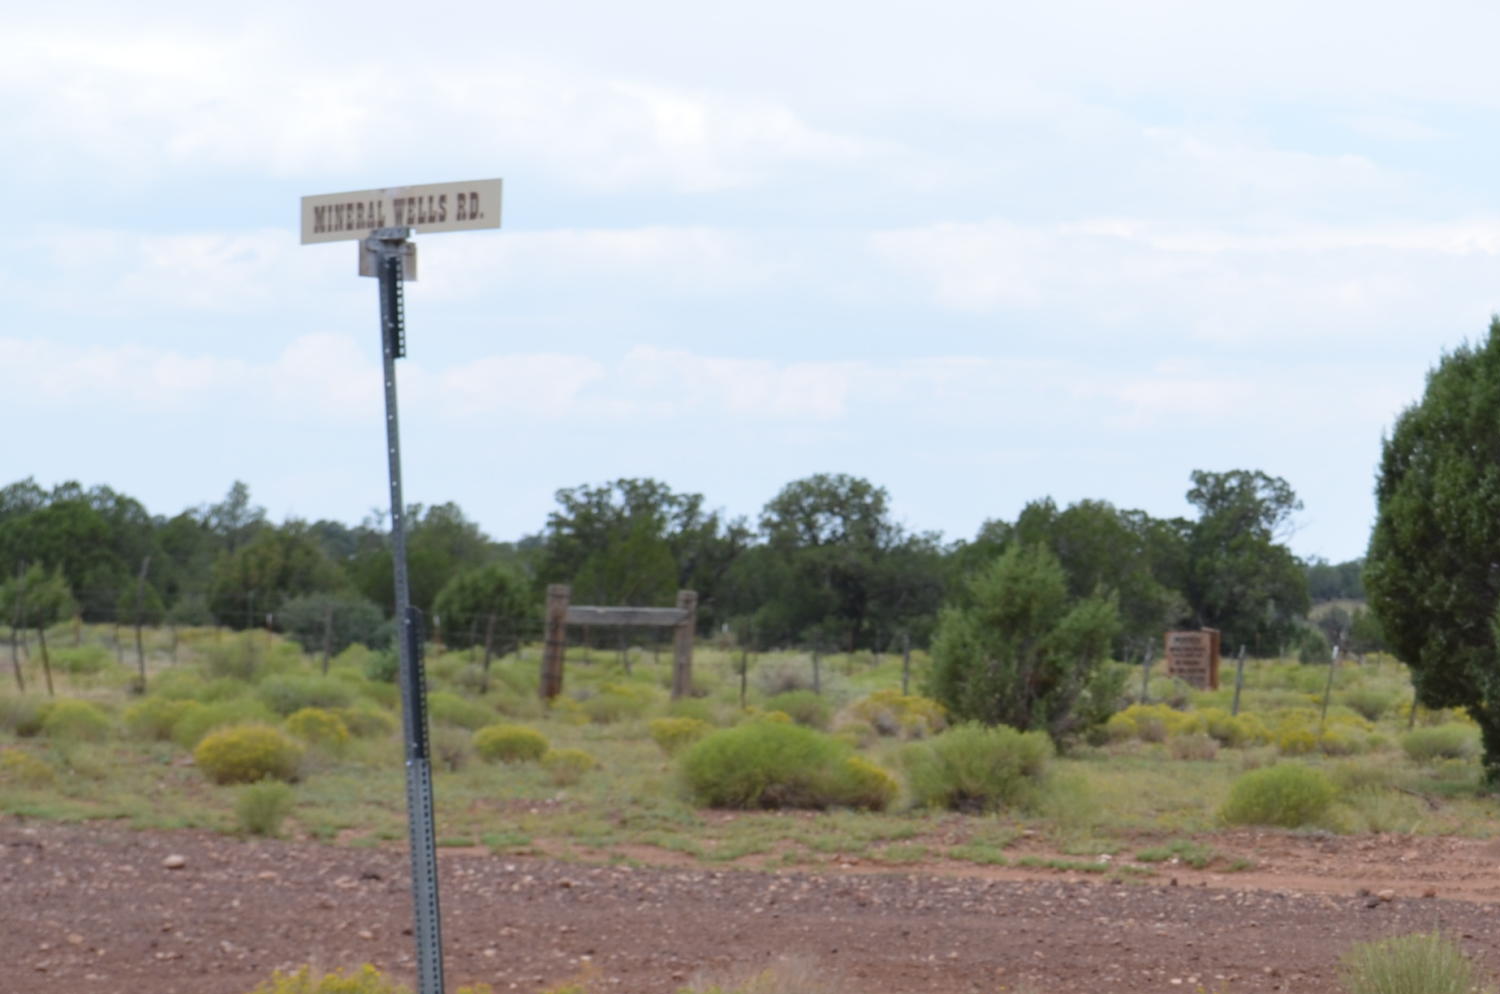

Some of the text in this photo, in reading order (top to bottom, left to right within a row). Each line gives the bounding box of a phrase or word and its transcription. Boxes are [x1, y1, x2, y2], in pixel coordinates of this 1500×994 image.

[313, 191, 485, 234] MINERAL WELLS RD.
